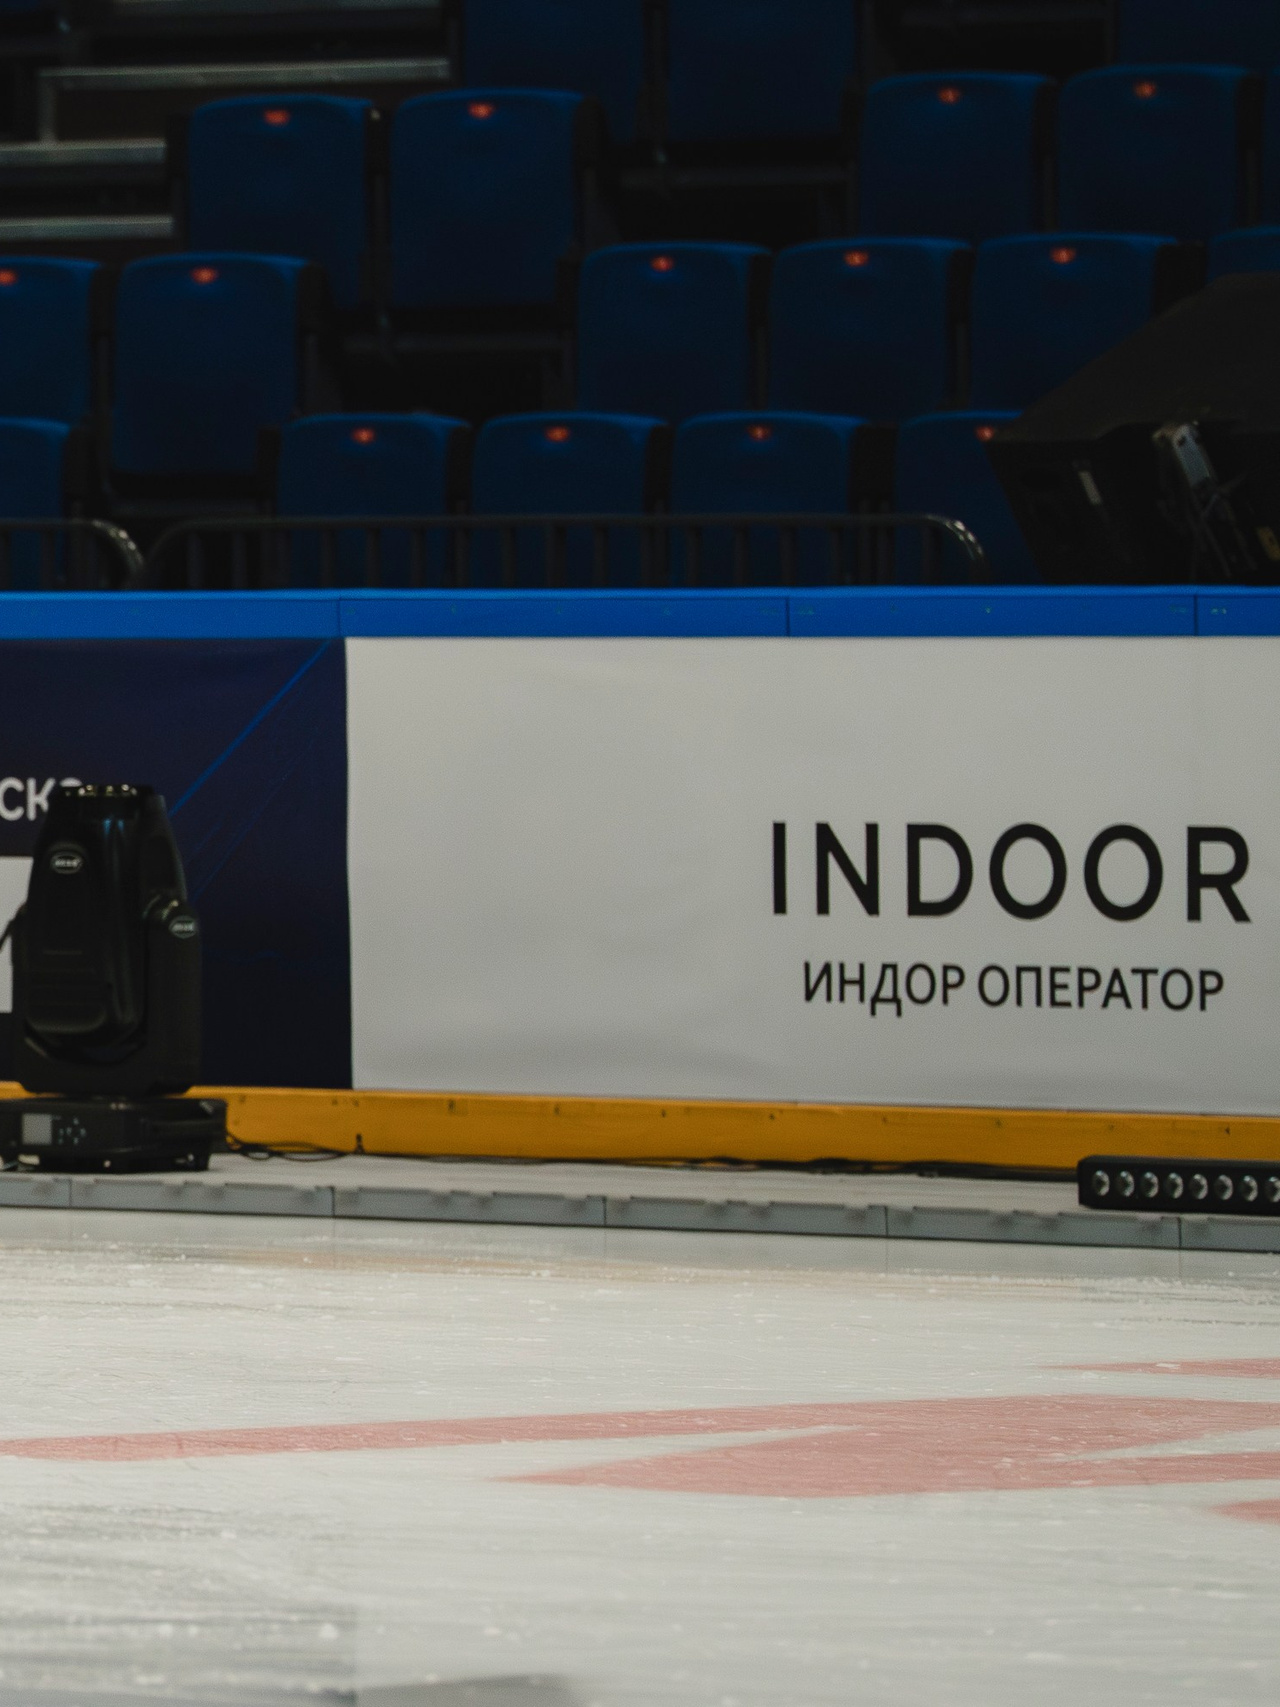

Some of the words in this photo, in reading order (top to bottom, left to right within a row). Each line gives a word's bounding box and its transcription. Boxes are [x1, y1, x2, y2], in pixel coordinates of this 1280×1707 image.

[772, 821, 1252, 923] INDOOR
[803, 960, 966, 1018] ИНДОР
[977, 964, 1225, 1012] ОПЕРАТОР
